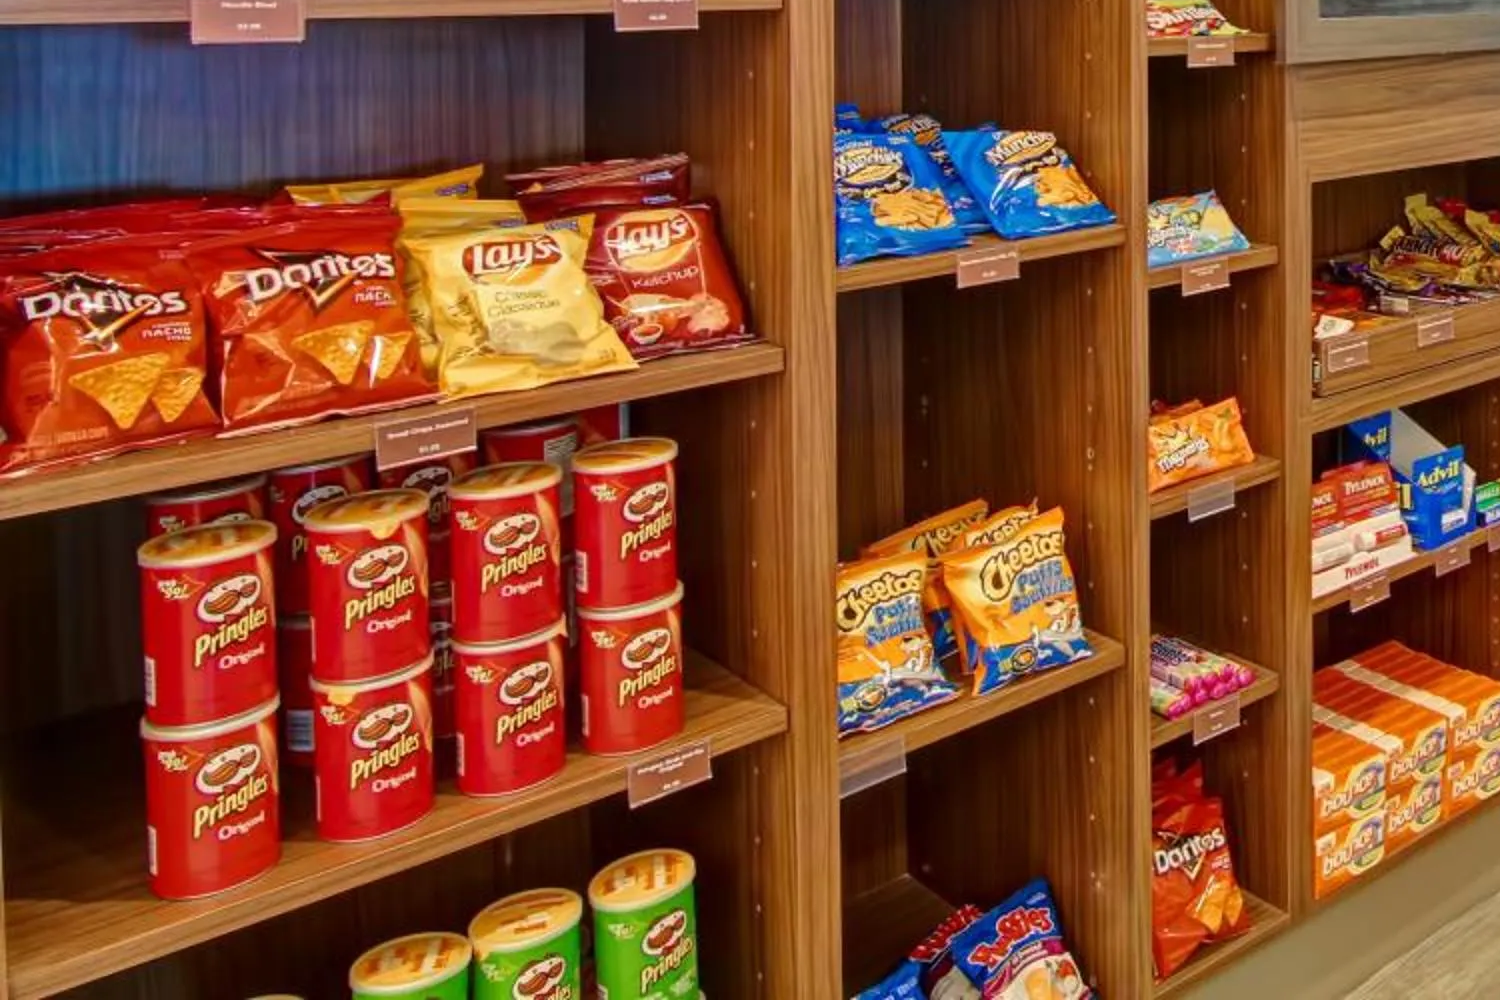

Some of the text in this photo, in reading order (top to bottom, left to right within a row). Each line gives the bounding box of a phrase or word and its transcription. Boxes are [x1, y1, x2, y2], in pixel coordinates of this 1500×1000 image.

[472, 234, 553, 281] Lay's
[615, 216, 690, 259] Lay's
[246, 251, 396, 301] Doritos
[631, 264, 701, 290] Ketchup
[23, 289, 187, 321] Doritos
[1417, 460, 1461, 489] Advil
[621, 509, 674, 559] Pringles
[481, 541, 548, 593] Pringles
[980, 530, 1065, 602] Cheetos
[345, 574, 416, 630] Pringles
[836, 569, 923, 632] Cheetos
[194, 604, 268, 667] Pringles
[618, 654, 677, 708] Pringles
[496, 690, 558, 745] Pringles
[350, 729, 420, 790] Pringles
[194, 772, 268, 839] Pringles
[1153, 827, 1226, 876] Doritos
[639, 933, 697, 996] Pringles
